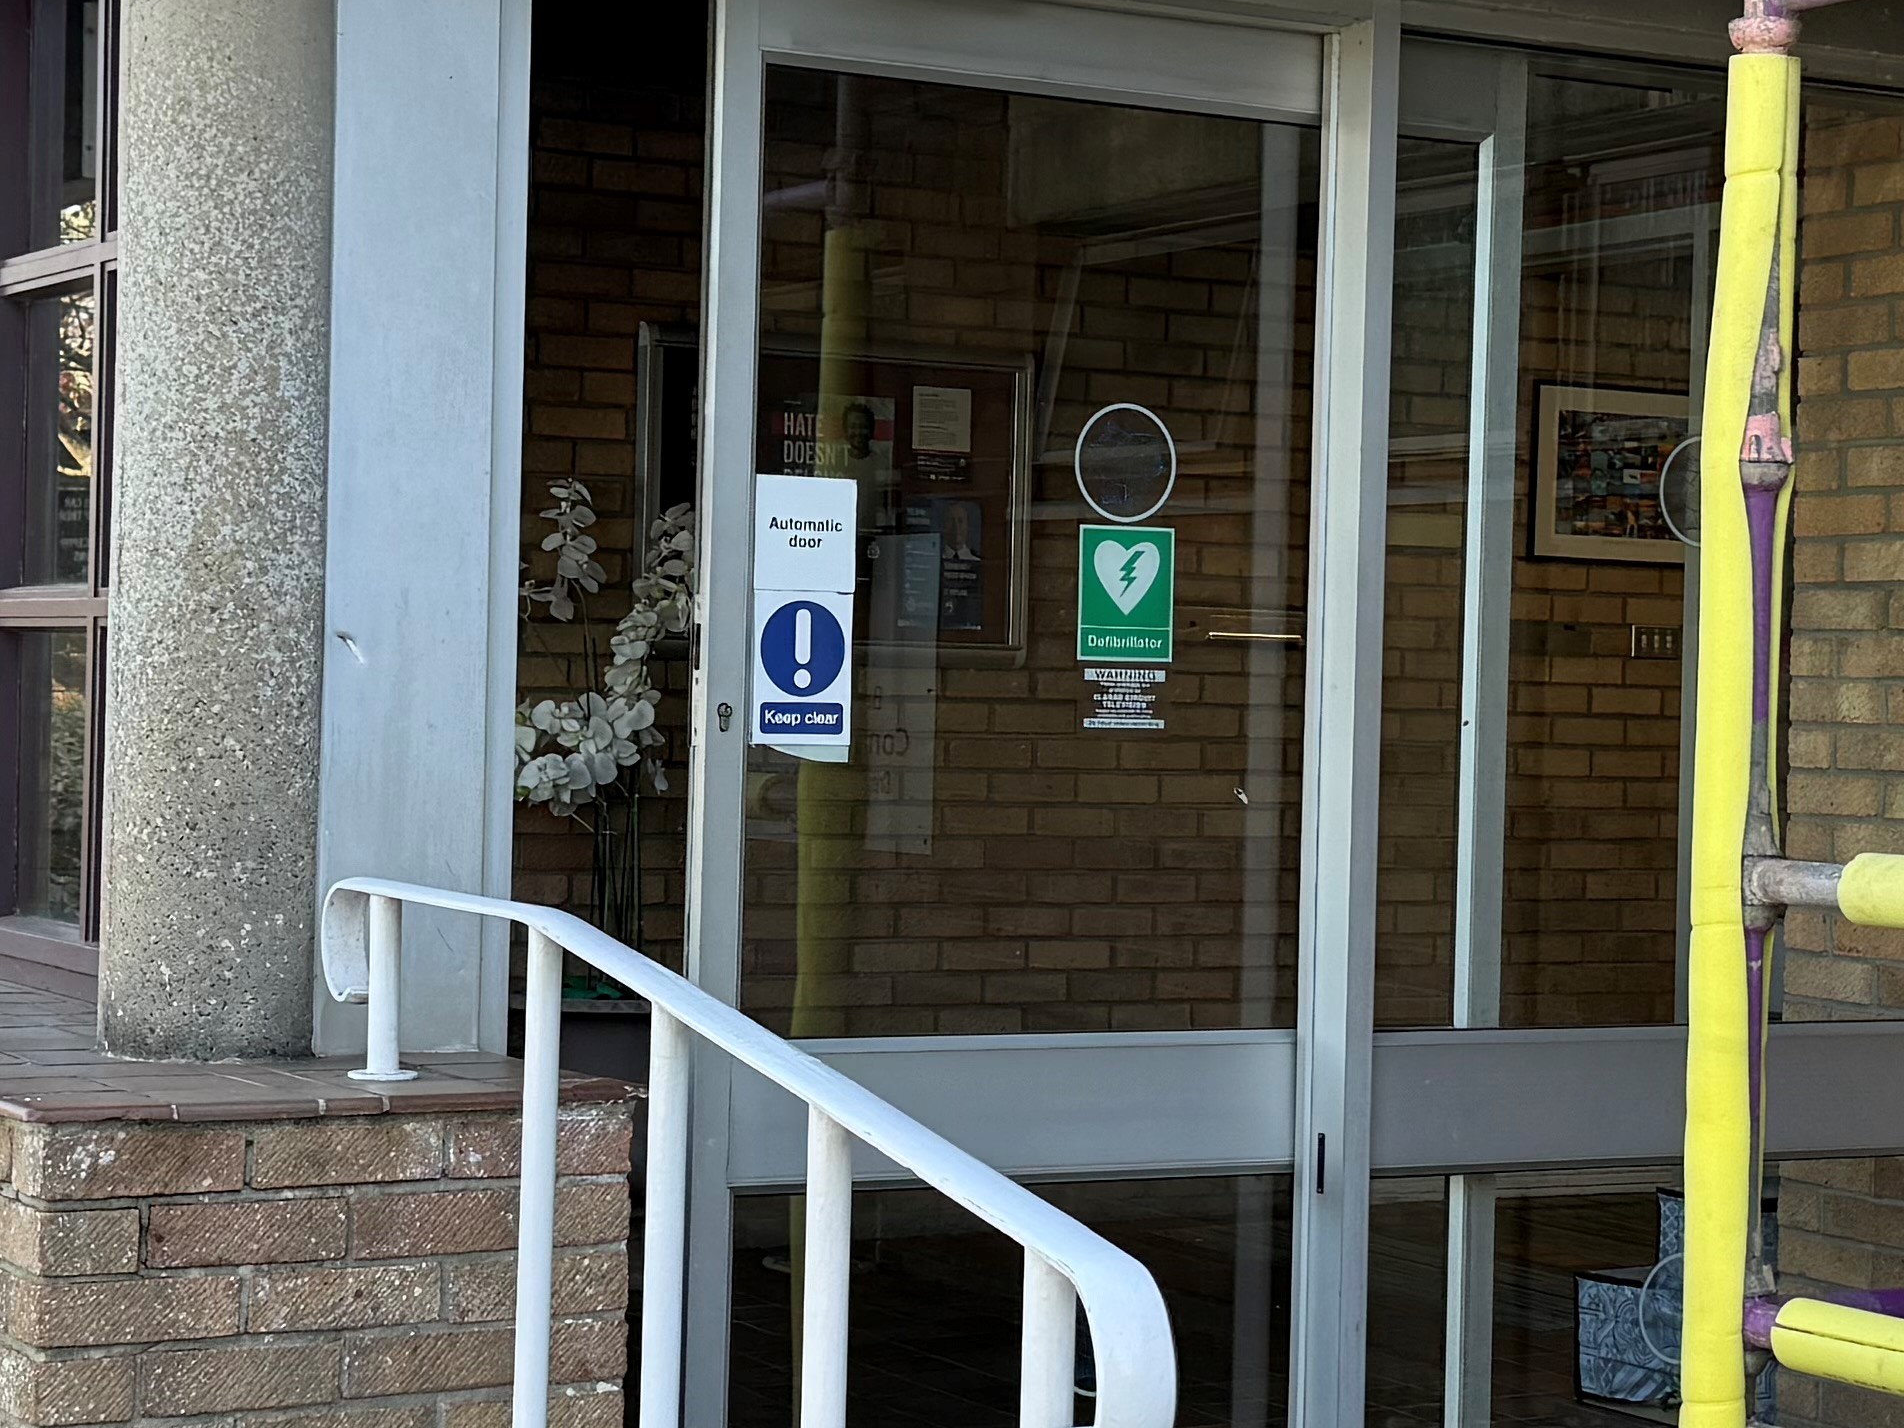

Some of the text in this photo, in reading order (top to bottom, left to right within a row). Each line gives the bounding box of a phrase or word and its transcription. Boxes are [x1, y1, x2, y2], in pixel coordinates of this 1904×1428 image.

[783, 412, 825, 437] HATE
[783, 440, 852, 467] DOESN'T
[769, 517, 843, 532] Automatic
[789, 535, 823, 548] door
[1087, 634, 1163, 649] Defibrillator
[1095, 670, 1156, 681] WARNING
[764, 709, 839, 727] Keep clear
